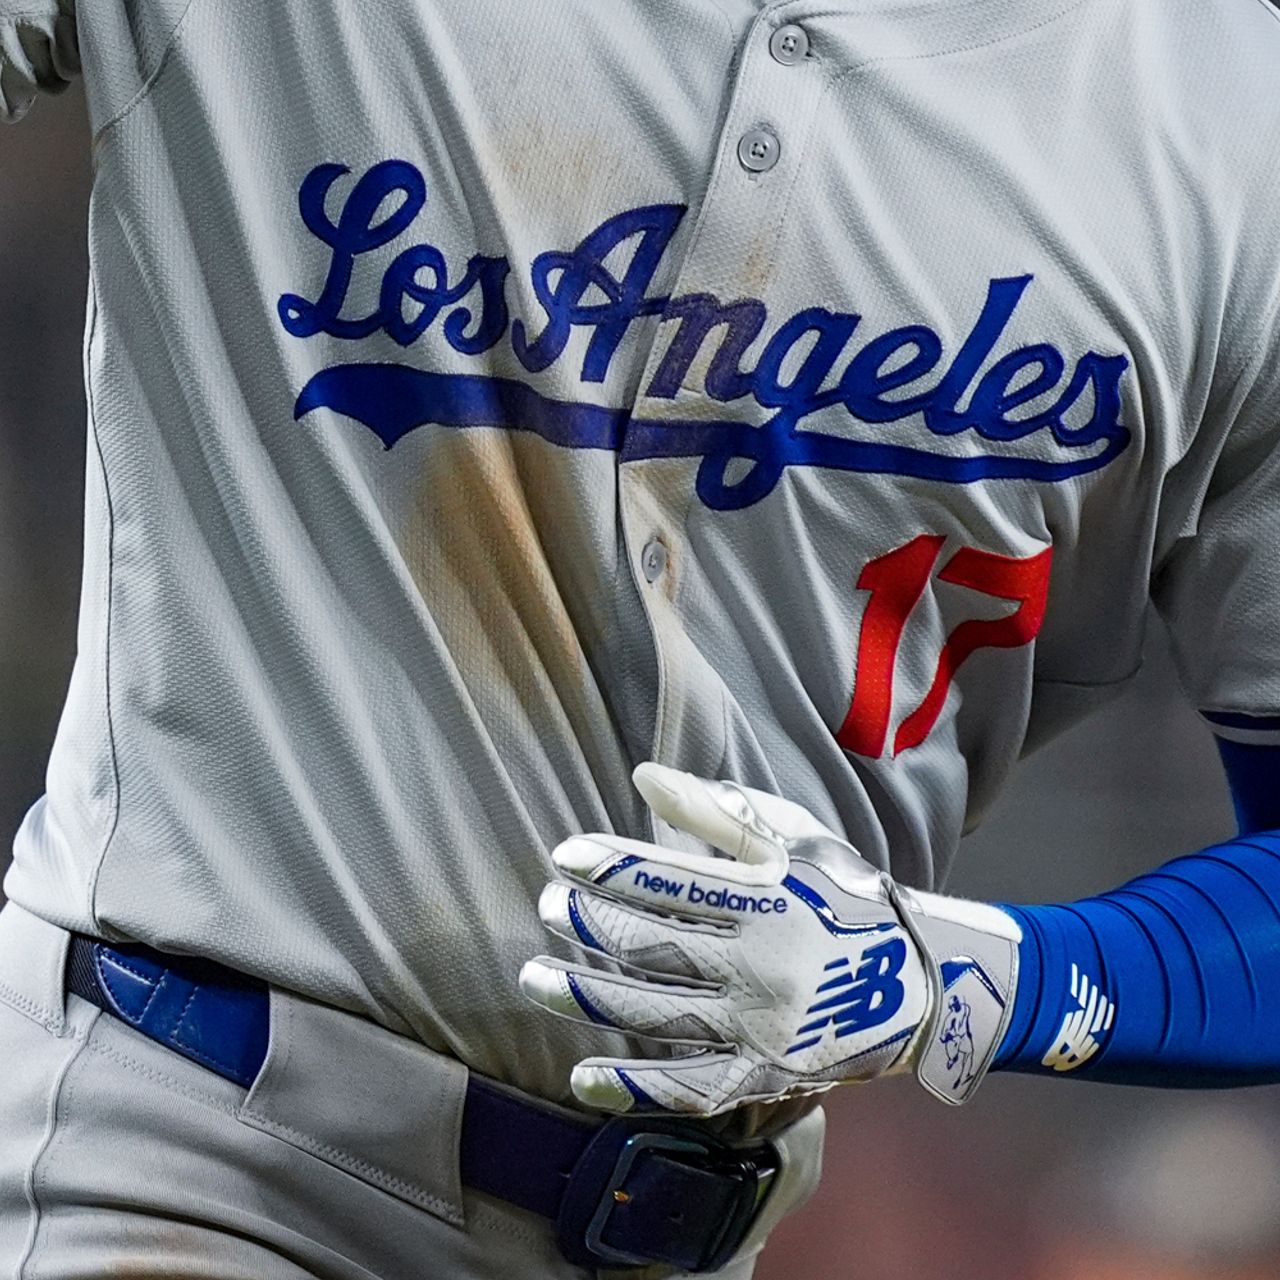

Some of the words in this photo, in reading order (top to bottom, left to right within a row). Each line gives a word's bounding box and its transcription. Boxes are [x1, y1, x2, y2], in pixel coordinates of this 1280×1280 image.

[279, 158, 512, 357] Los
[510, 202, 1131, 512] Angeles
[837, 534, 1053, 760] 17
[634, 870, 684, 898] new
[687, 880, 788, 914] balance
